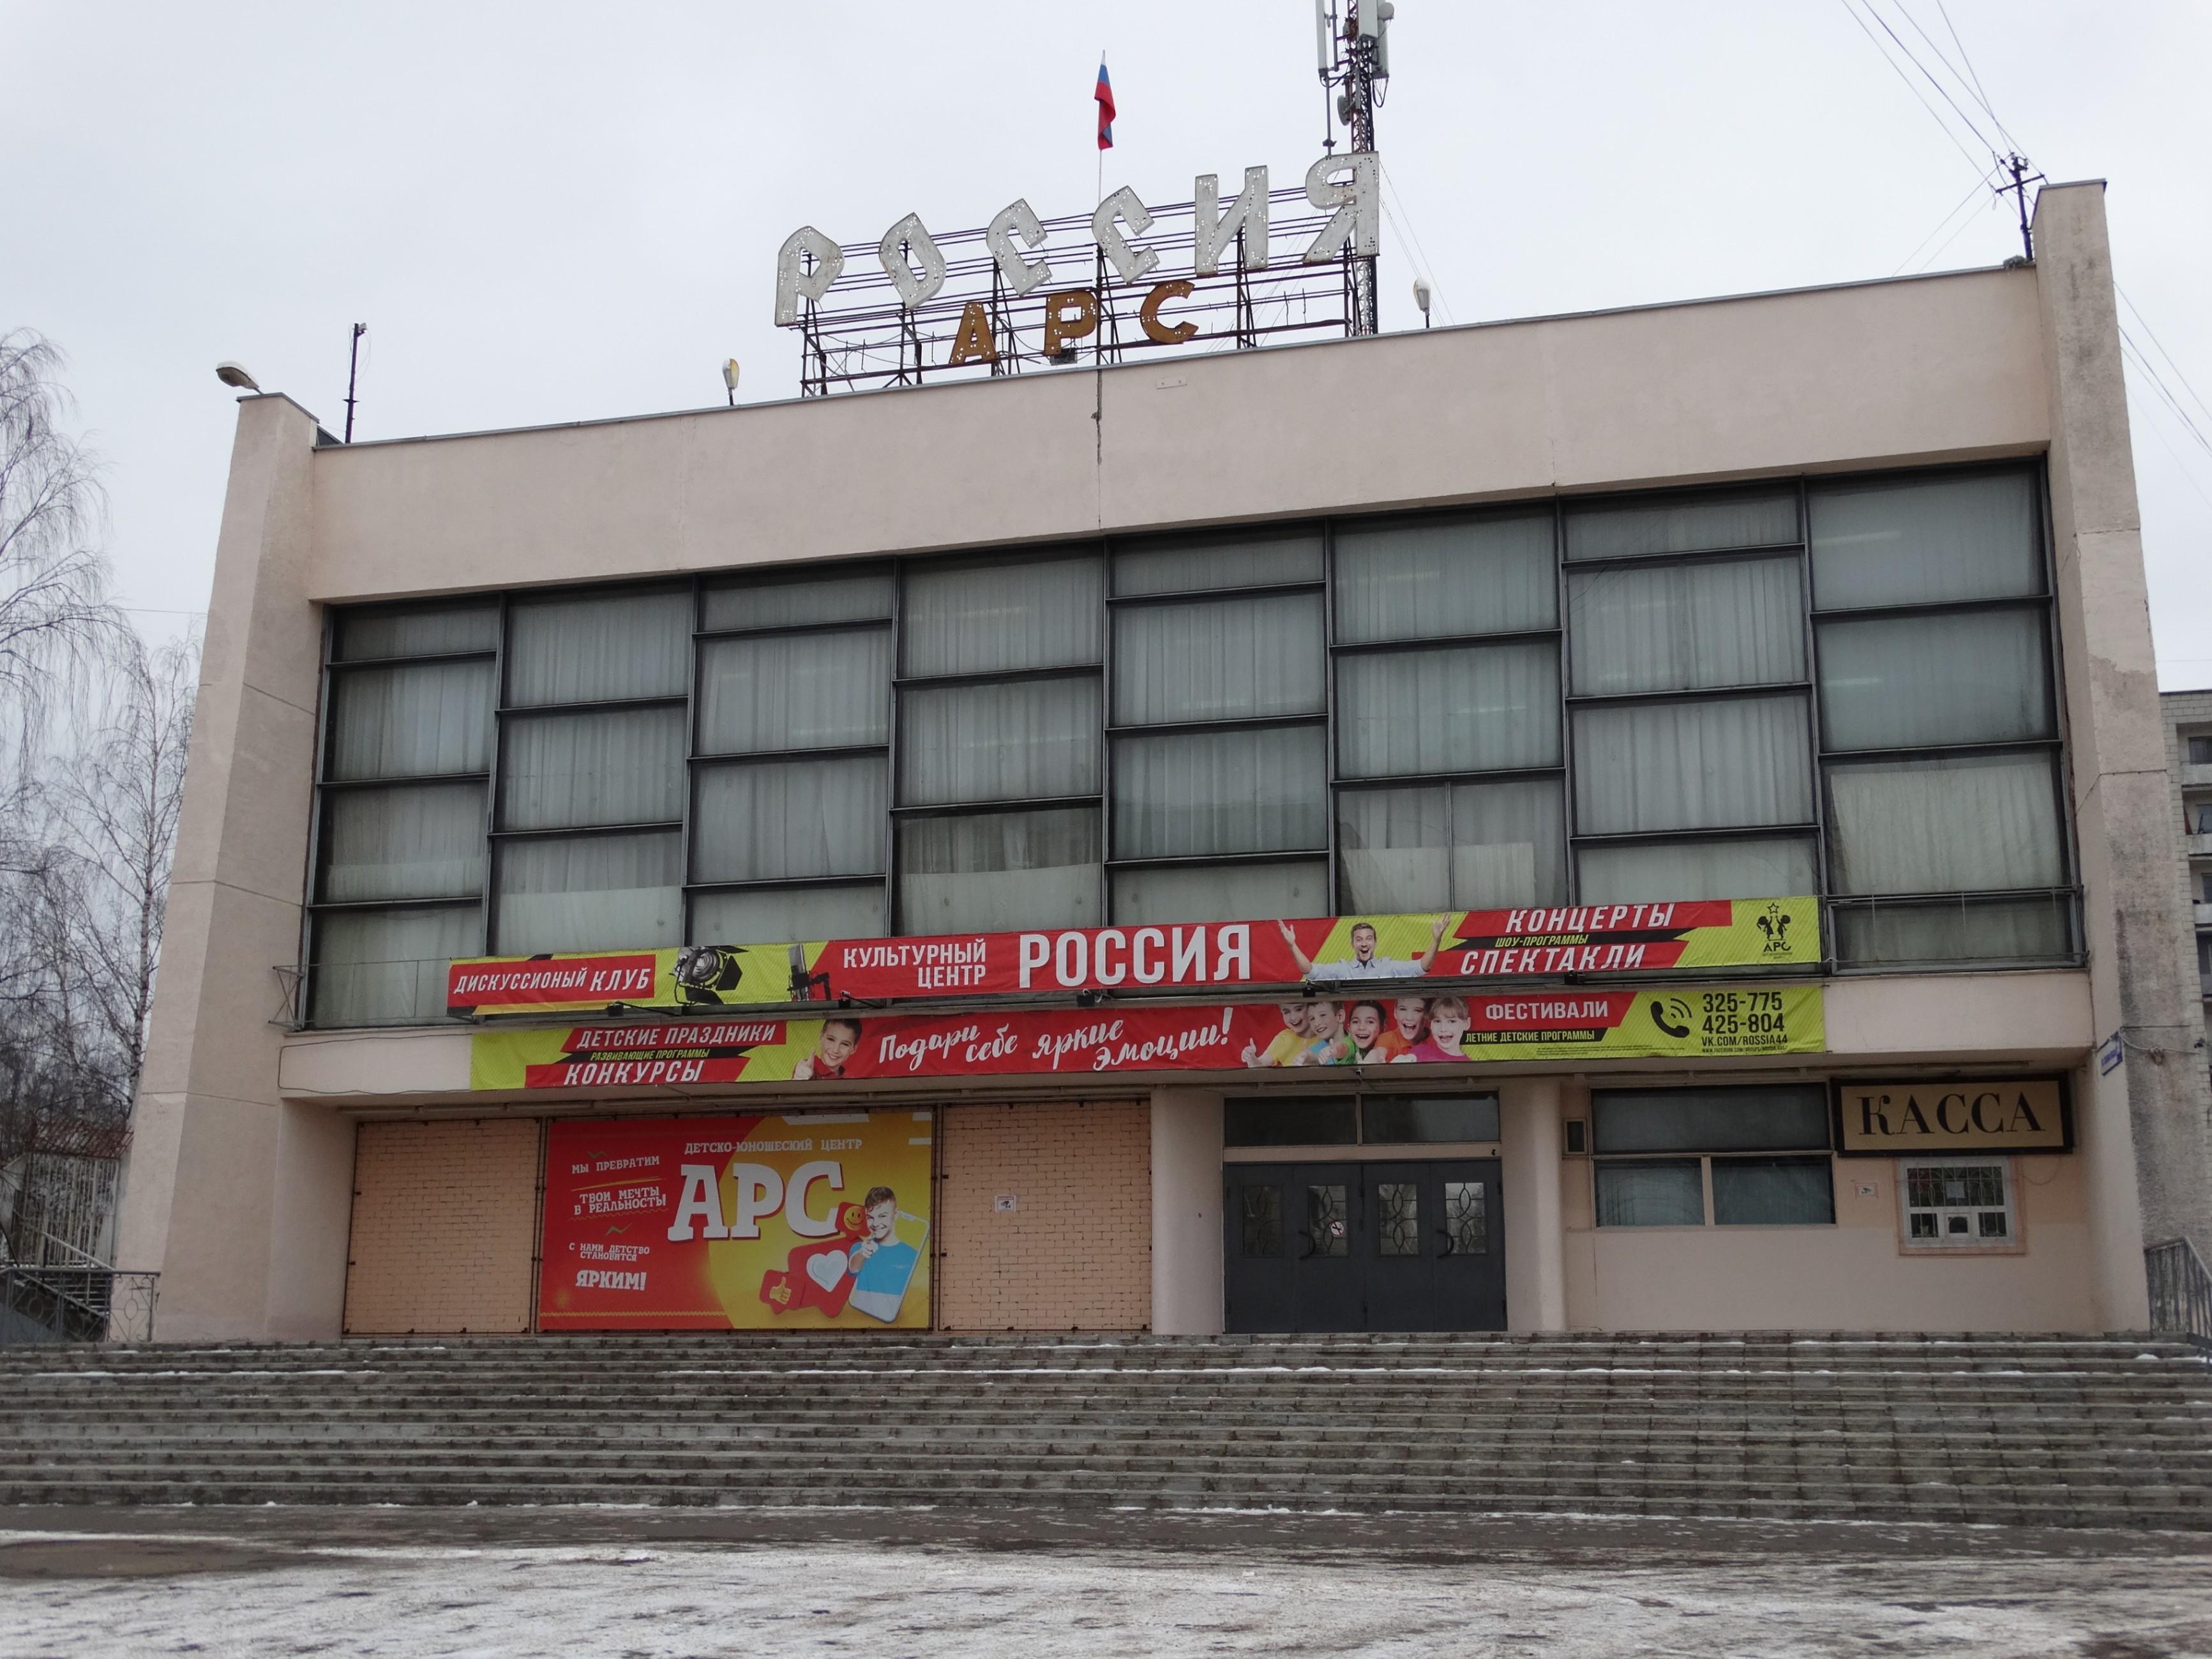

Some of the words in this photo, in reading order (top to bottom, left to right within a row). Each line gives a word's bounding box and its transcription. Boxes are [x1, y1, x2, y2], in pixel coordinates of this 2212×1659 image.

[774, 150, 1380, 327] РОССИЯ
[949, 279, 1199, 366] АРС
[1505, 903, 1675, 934] КОНЦЕРТЫ
[1494, 934, 1588, 947] ШОУ-ПРОГРАММЫ
[1763, 942, 1791, 952] АРС
[843, 938, 986, 968] КУЛЬТУРНЫЙ
[1019, 924, 1250, 988] РОССИЯ
[1460, 945, 1646, 974] СПЕКТАКЛИ
[453, 967, 588, 994] ДИСКУССИОНЫЙ
[589, 968, 651, 992] КЛУБ
[917, 965, 986, 989] ЦЕНТР
[1486, 1001, 1608, 1020] ФЕСТИВАЛИ
[1703, 991, 1782, 1012] 325-775
[1702, 1013, 1785, 1034] 425-804
[576, 1028, 662, 1049] ДЕТСКИЕ
[665, 1025, 777, 1045] ПРАЗДНИКИ
[879, 1025, 981, 1071] Подари
[965, 1023, 1018, 1062] себе
[1032, 1019, 1124, 1070] яркие
[1465, 1032, 1498, 1042] ЛЕТНИЕ
[1500, 1031, 1539, 1042] ДЕТСКИЕ
[1541, 1030, 1595, 1040] ПРОГРАММЫ
[1701, 1034, 1787, 1047] VK.COM/ROSSIA44
[590, 1051, 656, 1062] РАЗВИВАЮЩИЕ
[657, 1049, 710, 1059] ПРОГРАММЫ
[564, 1060, 705, 1085] КОНКУРСЫ
[1856, 1091, 2047, 1135] КАССА
[684, 1139, 813, 1155] ДЕТСКО-ЮНОШЕСКИЙ
[821, 1139, 862, 1151] ЦЕНТР
[572, 1164, 589, 1174] МЫ
[596, 1156, 660, 1171] ПРЕВРАТИМ
[575, 1205, 582, 1215] В
[589, 1194, 666, 1213] РЕАЛЬНОСТЬ!
[579, 1191, 611, 1204] ТВОИ
[619, 1186, 659, 1200] МЕЧТЫ
[667, 1160, 843, 1242] АРС
[569, 1242, 575, 1250] С
[580, 1243, 603, 1251] НАМИ
[609, 1245, 650, 1254] ДЕТСТВО
[580, 1251, 637, 1261] СТАНОВИТСЯ
[575, 1270, 647, 1291] ЯРКИМ!
